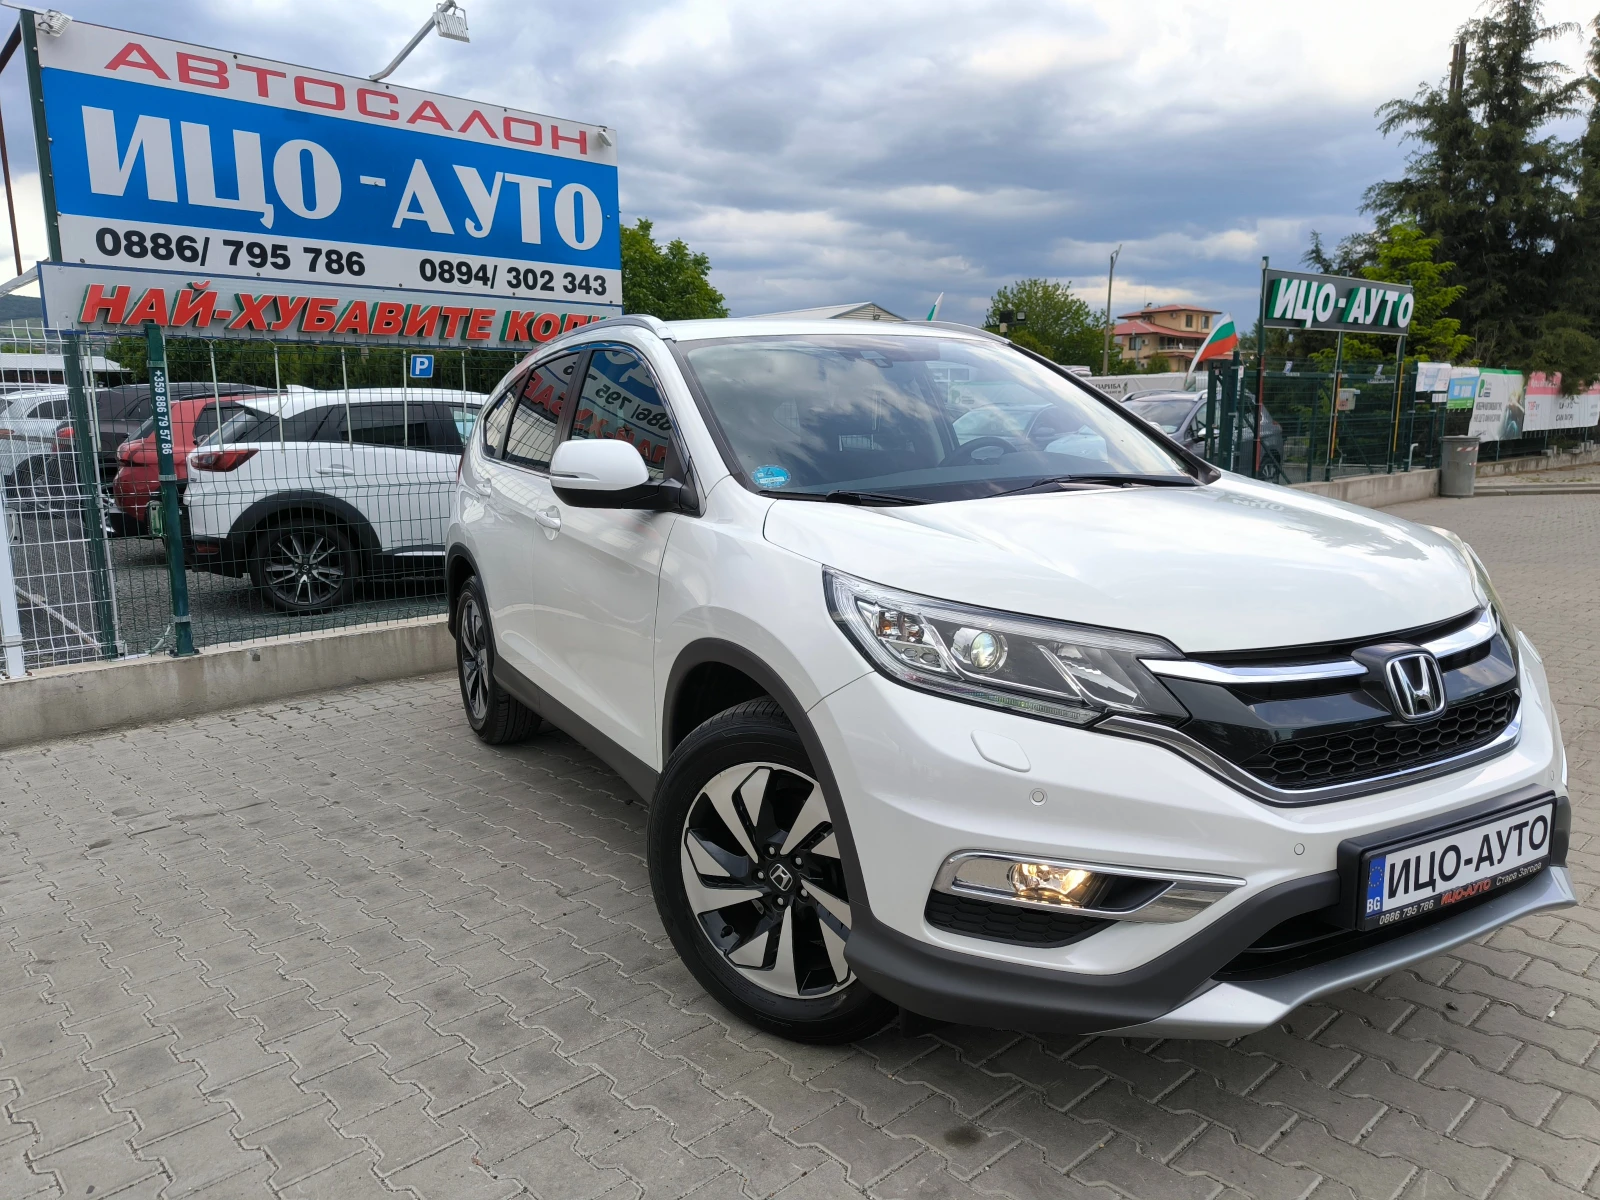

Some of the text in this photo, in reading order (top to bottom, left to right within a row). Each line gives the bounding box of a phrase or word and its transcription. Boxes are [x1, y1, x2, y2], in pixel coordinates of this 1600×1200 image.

[104, 42, 588, 155] АВТОСАЛОН
[95, 227, 366, 277] 0886/ 795 786
[419, 258, 607, 296] 0894/ 302 343
[81, 279, 496, 341] НАЙ-ХУБАВИТЕ
[1271, 277, 1414, 329] ИЦО-АУТО
[415, 357, 429, 375] P
[153, 369, 173, 455] +359 886 79 57 86
[1387, 814, 1549, 900] ИЦО-АУТО
[1366, 896, 1380, 913] BG
[1379, 862, 1542, 925] 0886 795 786 ИЦО-АУТО Стара Загора
